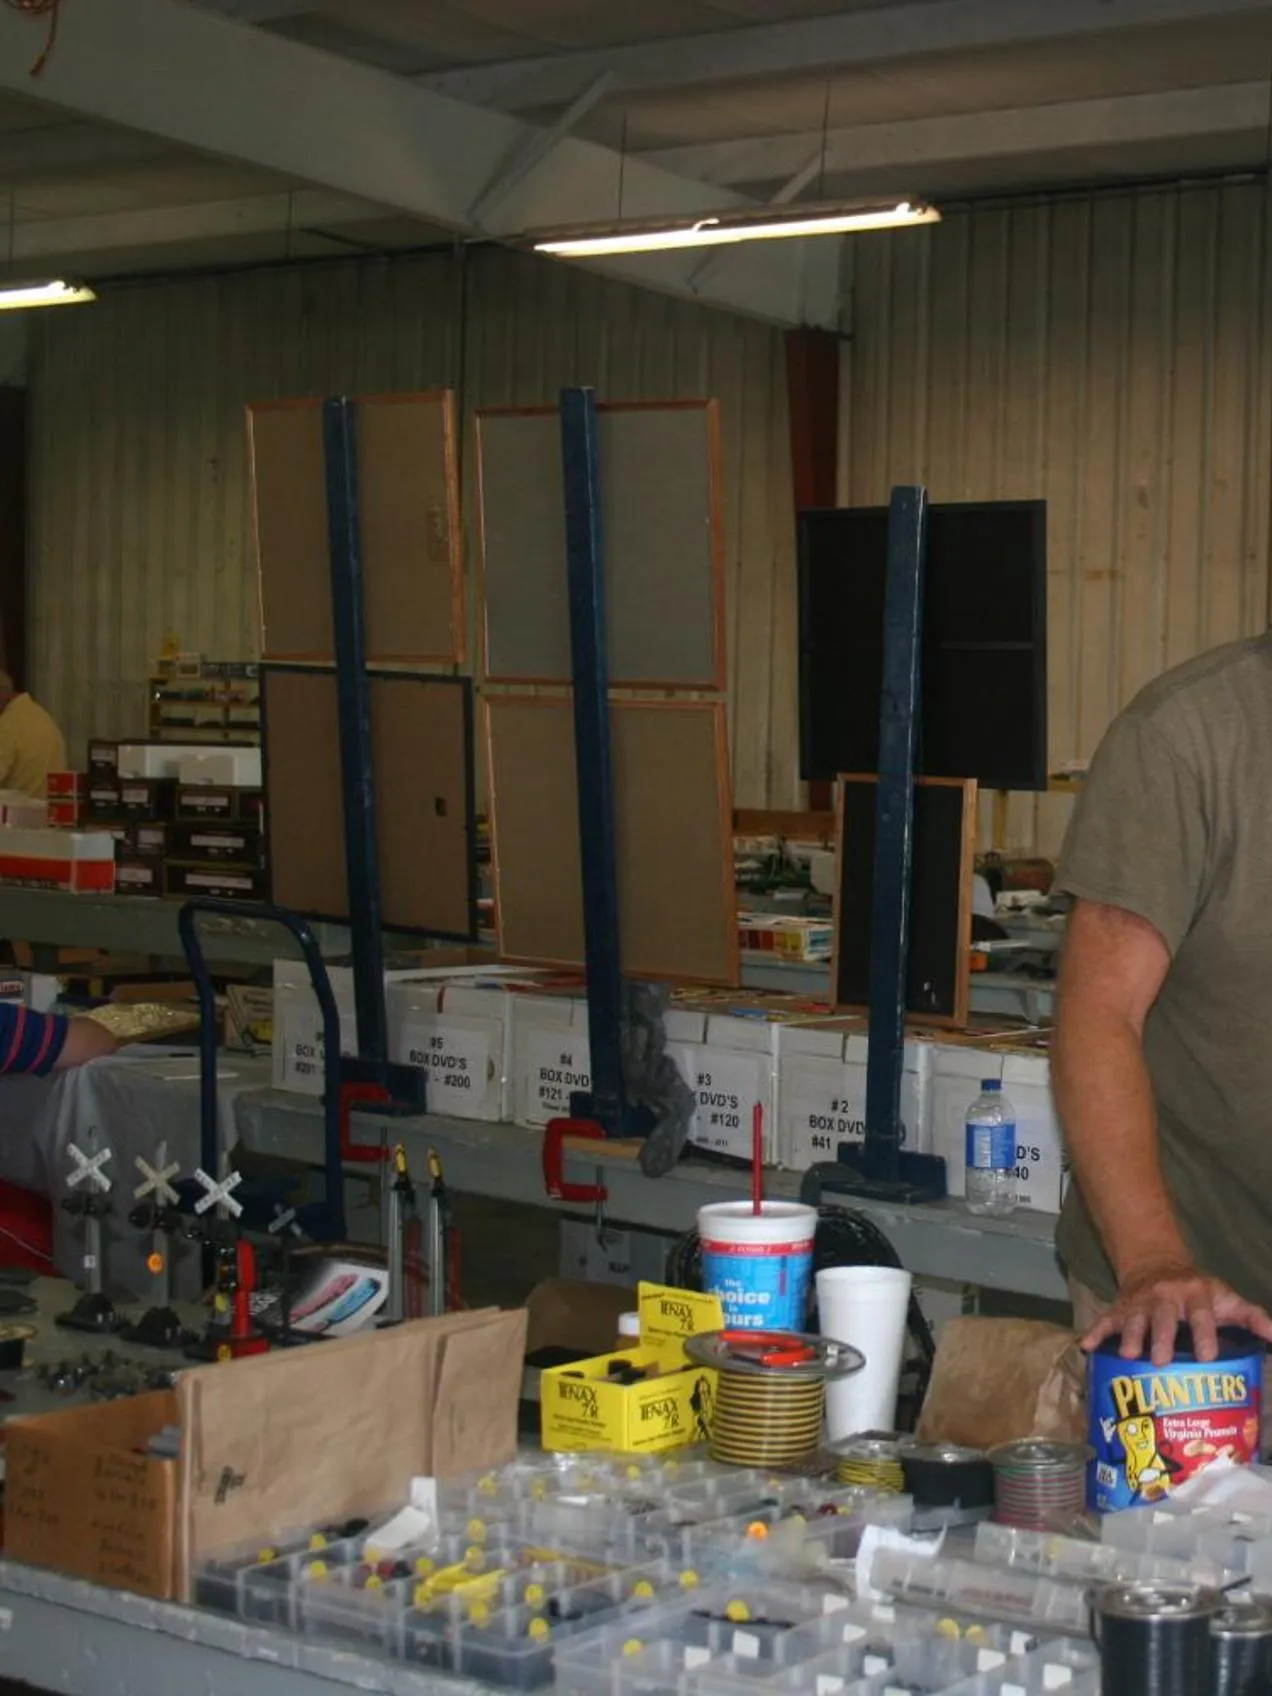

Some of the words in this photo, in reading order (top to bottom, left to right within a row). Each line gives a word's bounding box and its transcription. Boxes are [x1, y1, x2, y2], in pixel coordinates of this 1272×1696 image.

[430, 1037, 443, 1049] #5
[410, 1050, 429, 1065] BOX
[431, 1053, 467, 1070] DVD'S
[560, 1054, 572, 1066] #4
[443, 1075, 471, 1088] #200
[540, 1068, 562, 1083] BOX
[698, 1073, 711, 1086] #3
[700, 1091, 738, 1110] DVD'S
[710, 1114, 740, 1128] #120
[809, 1114, 835, 1130] BOX
[811, 1135, 831, 1149] #41
[1016, 1145, 1040, 1161] D'S
[723, 1314, 764, 1327] ours
[1112, 1373, 1246, 1417] PLANTERS
[1163, 1417, 1185, 1427] Extra
[1187, 1417, 1210, 1428] Large
[1163, 1426, 1203, 1441] Virginia
[1204, 1426, 1238, 1438] Peanuts
